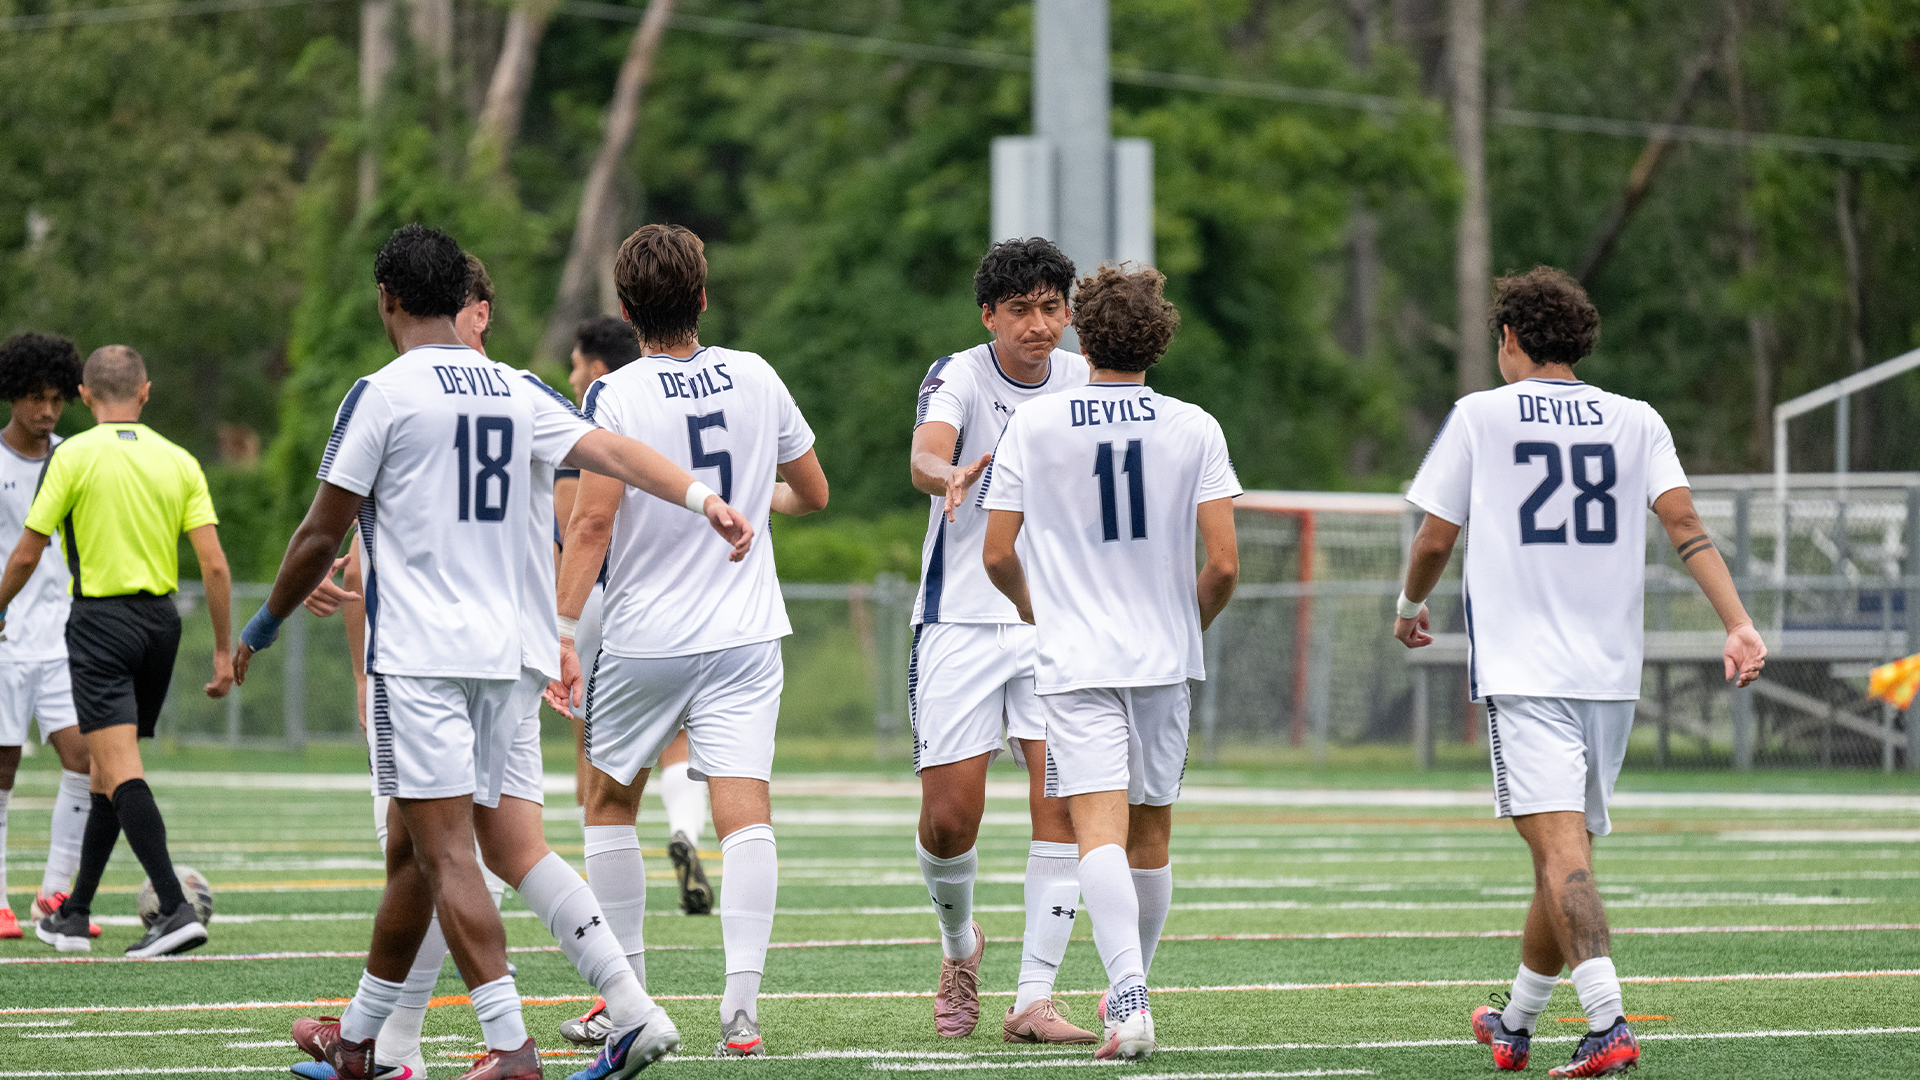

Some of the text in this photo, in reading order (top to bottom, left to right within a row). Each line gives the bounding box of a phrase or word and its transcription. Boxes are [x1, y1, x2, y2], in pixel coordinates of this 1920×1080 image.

[433, 365, 512, 397] DEVILS
[657, 363, 734, 399] DEVILS
[1070, 397, 1156, 427] DEVILS
[1517, 394, 1604, 426] DEVILS
[453, 413, 514, 523] 18
[685, 408, 734, 504] 5
[1092, 438, 1148, 542] 11
[1514, 440, 1618, 545] 28
